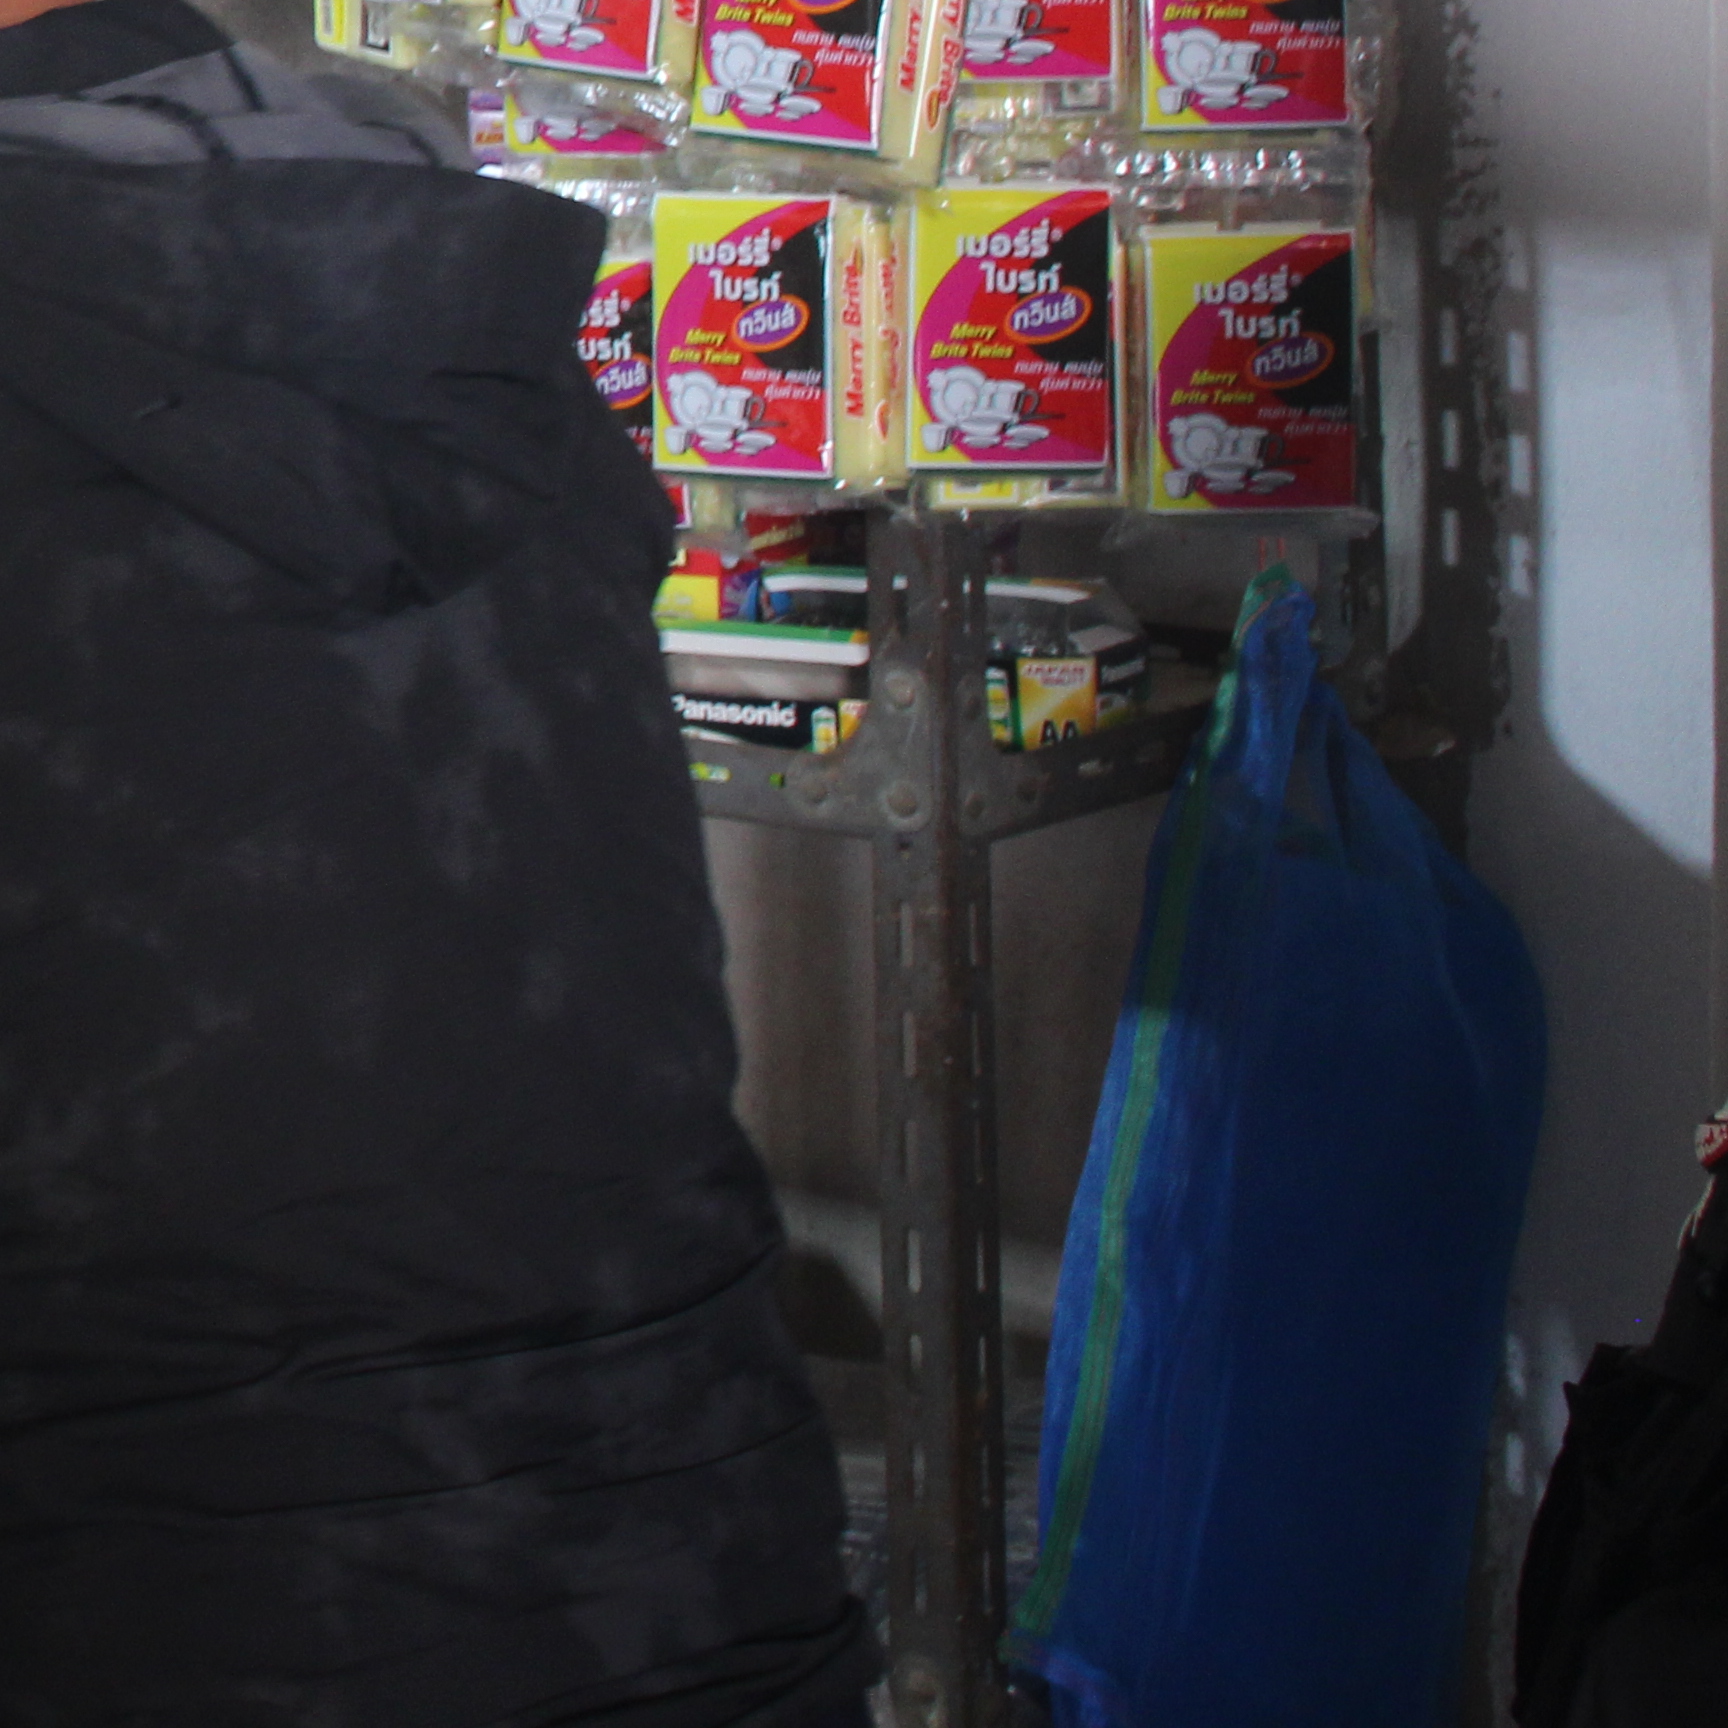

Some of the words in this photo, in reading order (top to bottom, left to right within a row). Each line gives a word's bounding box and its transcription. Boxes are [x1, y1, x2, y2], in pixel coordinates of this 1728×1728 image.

[899, 9, 922, 91] Merry
[688, 227, 772, 267] เมอร์รี่
[956, 218, 1051, 259] เมอร์รี่
[709, 267, 783, 302] ไบรท์
[980, 261, 1063, 297] ไบรท์
[1194, 264, 1289, 305] เมอร์รี่
[1219, 308, 1302, 340] ไบรท์
[577, 332, 632, 362] บรท์
